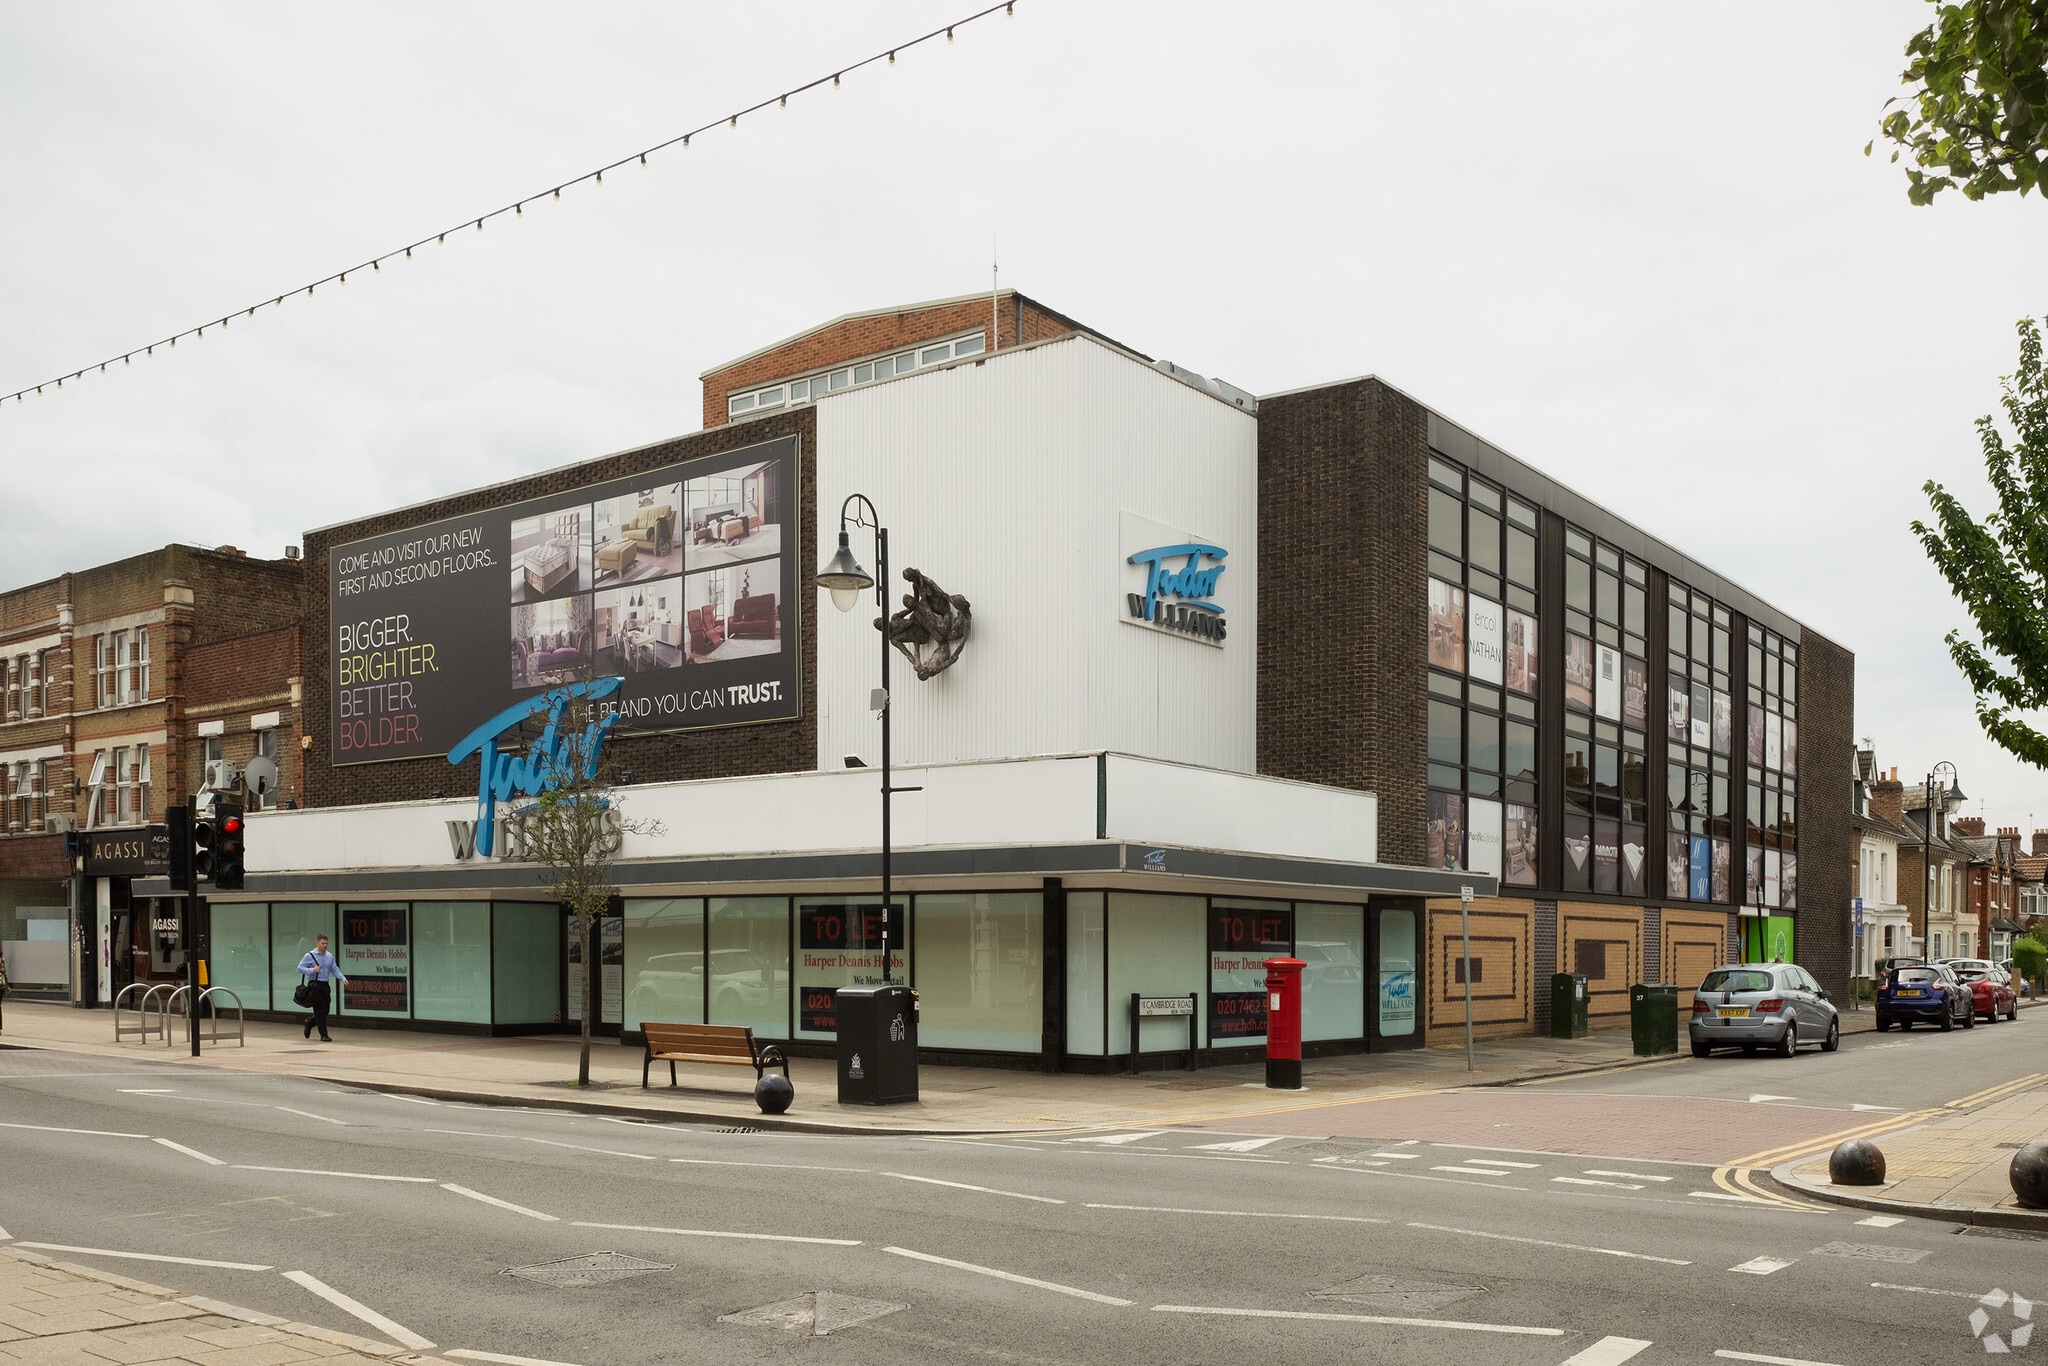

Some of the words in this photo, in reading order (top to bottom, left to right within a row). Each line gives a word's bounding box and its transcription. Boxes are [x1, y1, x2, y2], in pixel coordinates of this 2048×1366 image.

[338, 552, 370, 575] COME
[370, 547, 396, 568] AND
[396, 540, 423, 562] VISIT
[424, 533, 451, 556] OUR
[452, 526, 483, 550] NEW
[338, 575, 367, 597] FIRST
[368, 570, 393, 591] AND
[394, 559, 441, 586] SECOND
[442, 548, 498, 576] FLOORS...
[1127, 543, 1229, 621] Tudor
[1474, 612, 1497, 633] ercol
[339, 614, 413, 654] BIGGER.
[1469, 638, 1502, 664] NATHAN
[339, 643, 439, 686] BRIGHTER.
[340, 681, 417, 718] BETTER.
[654, 692, 687, 715] YOU
[690, 687, 725, 711] CAN
[727, 680, 783, 706] TRUST.
[340, 713, 423, 751] BOLDER.
[94, 841, 145, 860] AGASSI
[152, 918, 179, 931] AGASSI
[350, 918, 368, 937] TO
[374, 918, 399, 938] LET
[812, 916, 841, 940] TO
[1220, 917, 1244, 942] TO
[1251, 918, 1281, 943] LET
[345, 948, 366, 961] Harper
[366, 948, 387, 959] Dennis
[388, 949, 407, 959] Hobbs
[804, 954, 836, 970] Harper
[838, 954, 871, 968] Dennis
[1213, 957, 1240, 973] Harper
[853, 975, 865, 985] We
[865, 975, 883, 985] Move
[1253, 978, 1262, 988] We
[1382, 972, 1414, 1009] Tudor
[807, 994, 831, 1009] 020
[1146, 1000, 1176, 1009] CAMBRIDGE
[1177, 1000, 1193, 1009] ROAD
[1216, 999, 1237, 1015] 020
[1238, 999, 1261, 1014] 7462
[1381, 999, 1414, 1010] WILLIAMS
